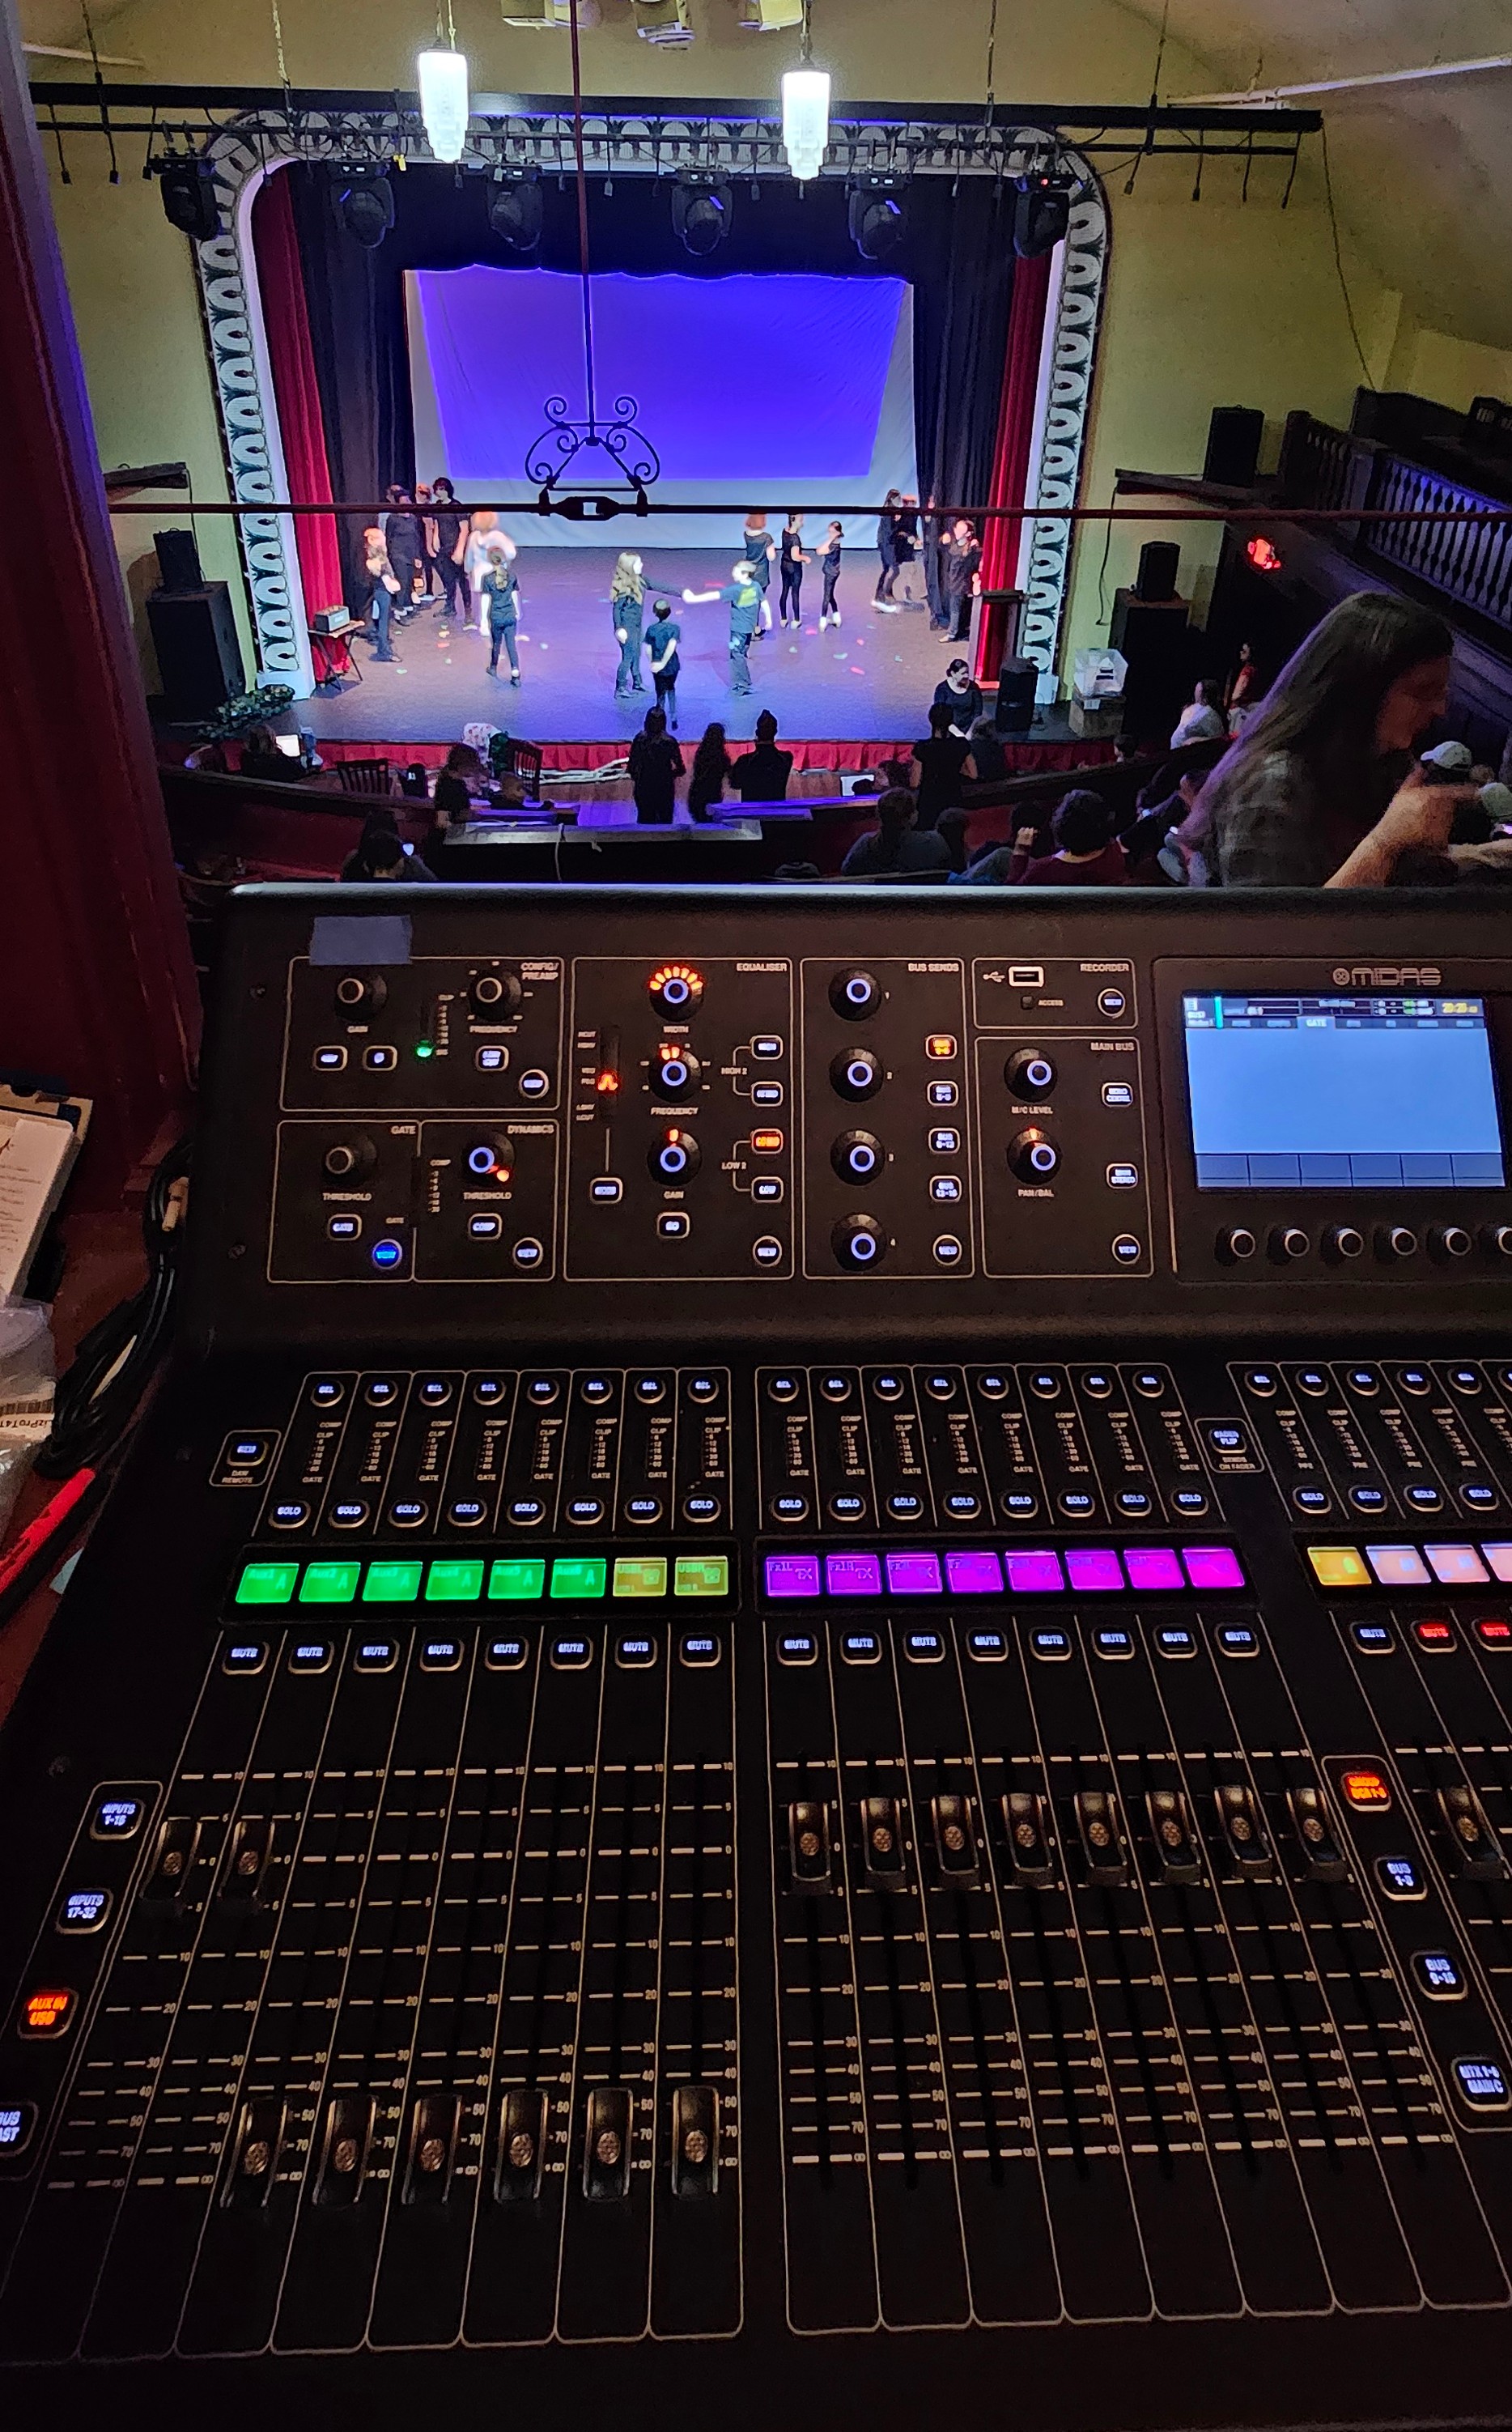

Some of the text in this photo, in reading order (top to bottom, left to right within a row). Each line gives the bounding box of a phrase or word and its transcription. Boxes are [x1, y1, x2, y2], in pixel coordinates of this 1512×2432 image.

[737, 963, 787, 972] EQUALISER
[1081, 963, 1129, 972] RECORDER
[1350, 968, 1442, 986] MIDAS
[391, 1126, 416, 1134] GATE
[508, 1125, 554, 1133] DYNAMICS
[840, 1935, 850, 1944] 10
[990, 1931, 1000, 1940] 10
[725, 1937, 735, 1946] 10
[1074, 1979, 1086, 1988] 20
[646, 1990, 657, 2000] 20
[724, 1988, 736, 1997] 20
[28, 1998, 53, 2010] AUX
[325, 1999, 338, 2009] 20
[486, 1995, 499, 2005] 20
[163, 2003, 176, 2013] 20
[643, 2043, 655, 2053] 30
[725, 2041, 737, 2051] 30
[479, 2048, 491, 2058] 30
[725, 2068, 737, 2078] 40
[476, 2076, 488, 2086] 40
[557, 2102, 570, 2112] 50
[725, 2097, 737, 2108] 50
[555, 2132, 567, 2142] 70
[726, 2127, 737, 2137] 70
[209, 2143, 222, 2154] 70
[295, 2140, 308, 2150] 70
